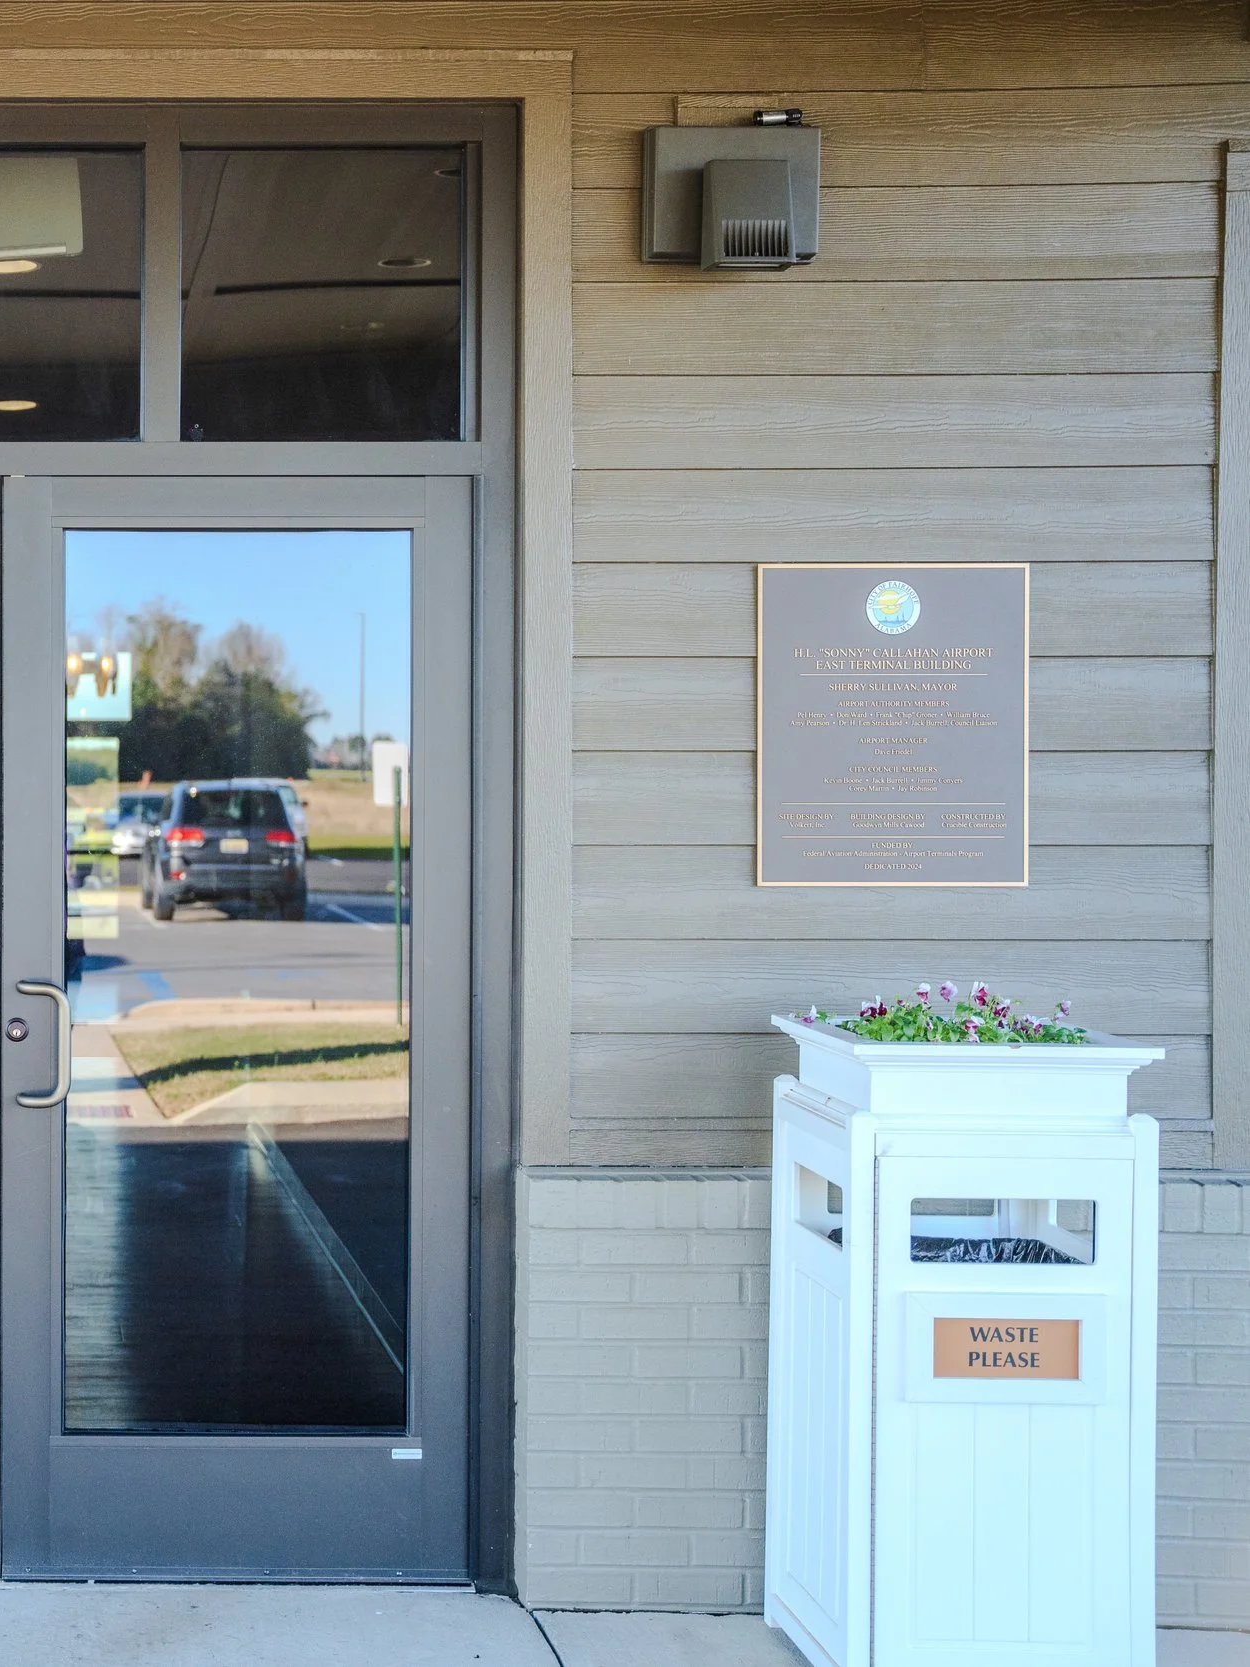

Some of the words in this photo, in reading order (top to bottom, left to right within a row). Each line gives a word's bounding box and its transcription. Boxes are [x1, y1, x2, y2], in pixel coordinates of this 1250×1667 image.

[868, 589, 880, 605] CITY
[888, 582, 920, 605] FAIRHOPE
[875, 623, 912, 634] ALABAMA
[793, 648, 816, 658] H.L.
[819, 648, 870, 658] "SONNY"
[872, 648, 939, 658] CALLAHAN
[942, 648, 993, 658] AIRPORT
[815, 660, 845, 670] EAST
[849, 660, 910, 670] TERMINAL
[913, 660, 971, 670] BUILDING
[828, 683, 866, 692] SHERRY
[869, 683, 920, 692] SULLIVAN,
[922, 683, 958, 692] MAYOR
[969, 1327, 1039, 1343] WASTE
[968, 1352, 1040, 1368] PLEASE
